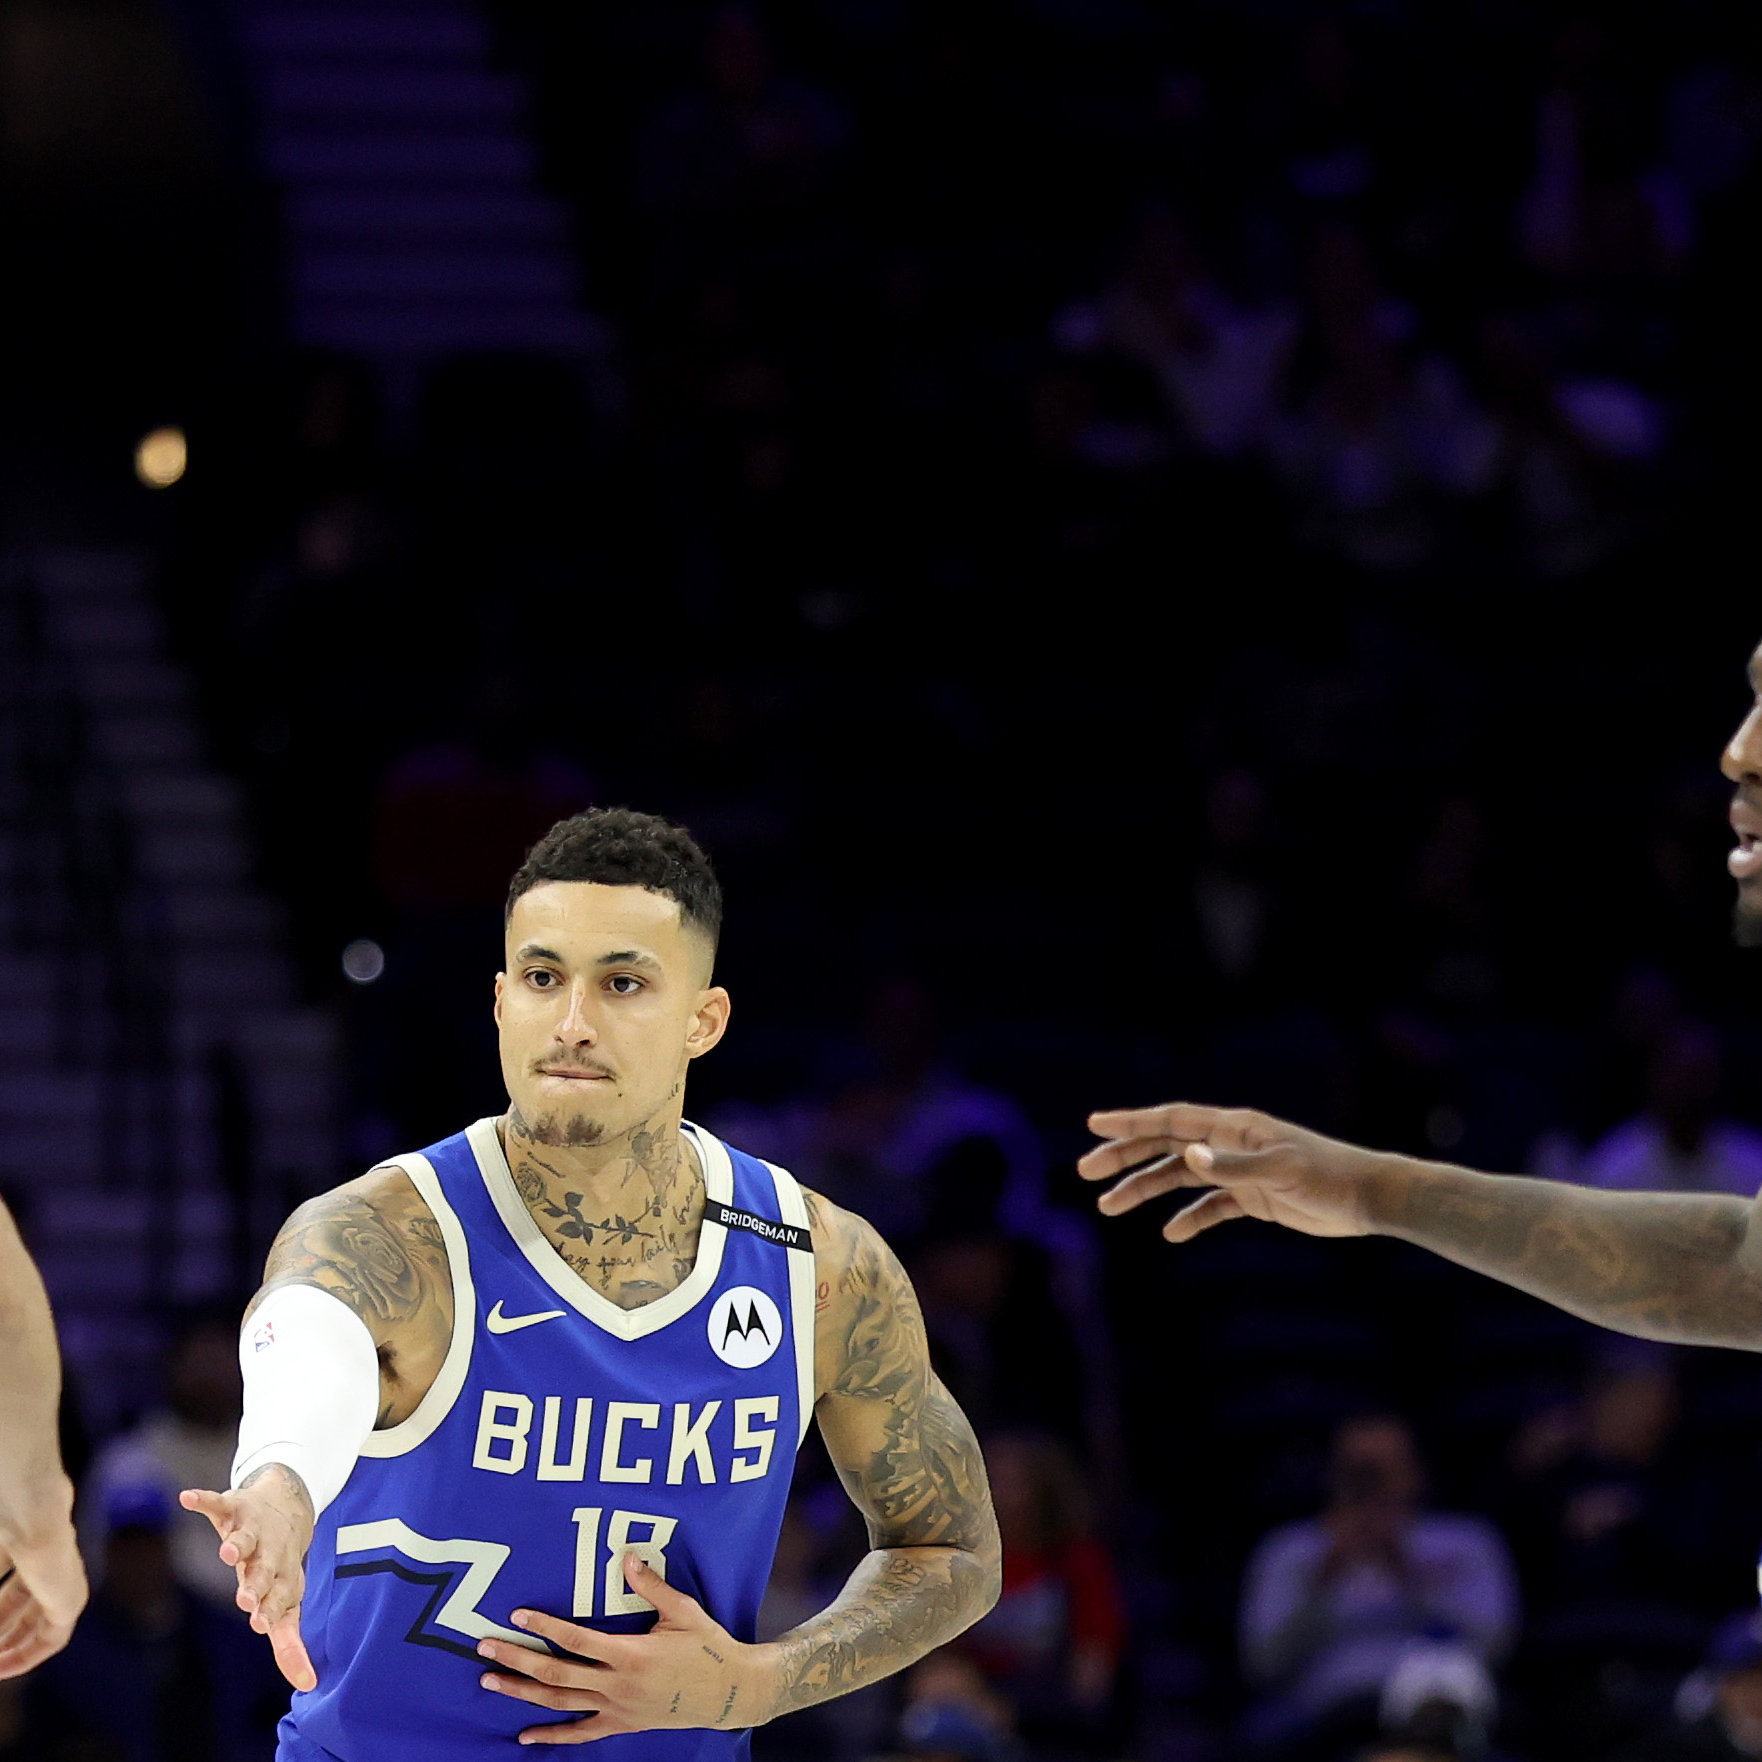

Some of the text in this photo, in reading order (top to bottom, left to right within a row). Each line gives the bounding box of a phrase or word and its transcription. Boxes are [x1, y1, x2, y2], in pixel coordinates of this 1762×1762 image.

[719, 1207, 799, 1245] BRIDGEMAN
[472, 1389, 780, 1486] BUCKS
[570, 1506, 679, 1619] 18
